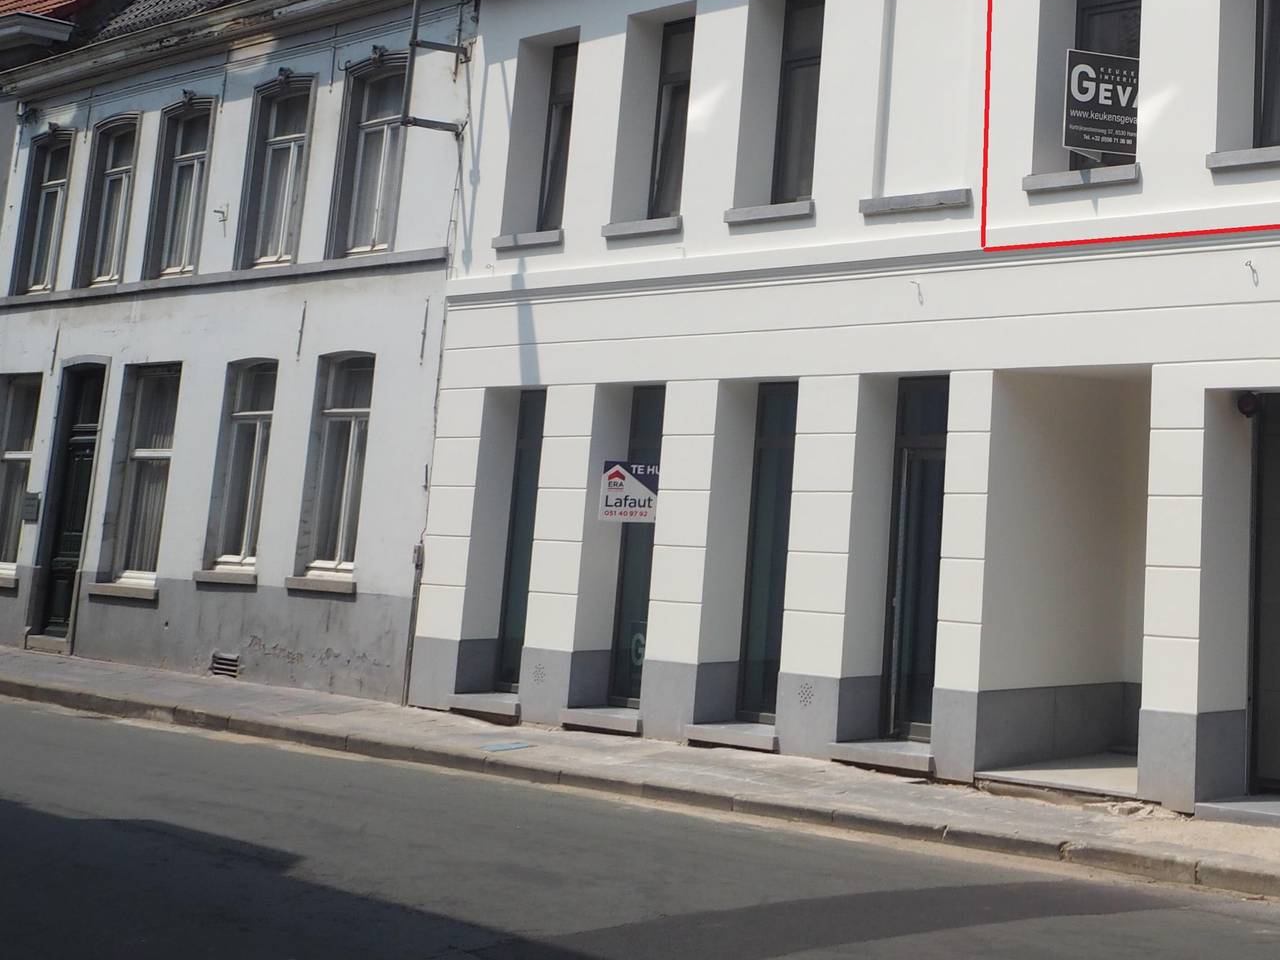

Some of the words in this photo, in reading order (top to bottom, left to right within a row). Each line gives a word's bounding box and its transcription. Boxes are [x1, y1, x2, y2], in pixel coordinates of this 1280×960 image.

[631, 464, 645, 475] TE
[608, 480, 624, 488] ERA
[605, 495, 653, 508] Lafaut
